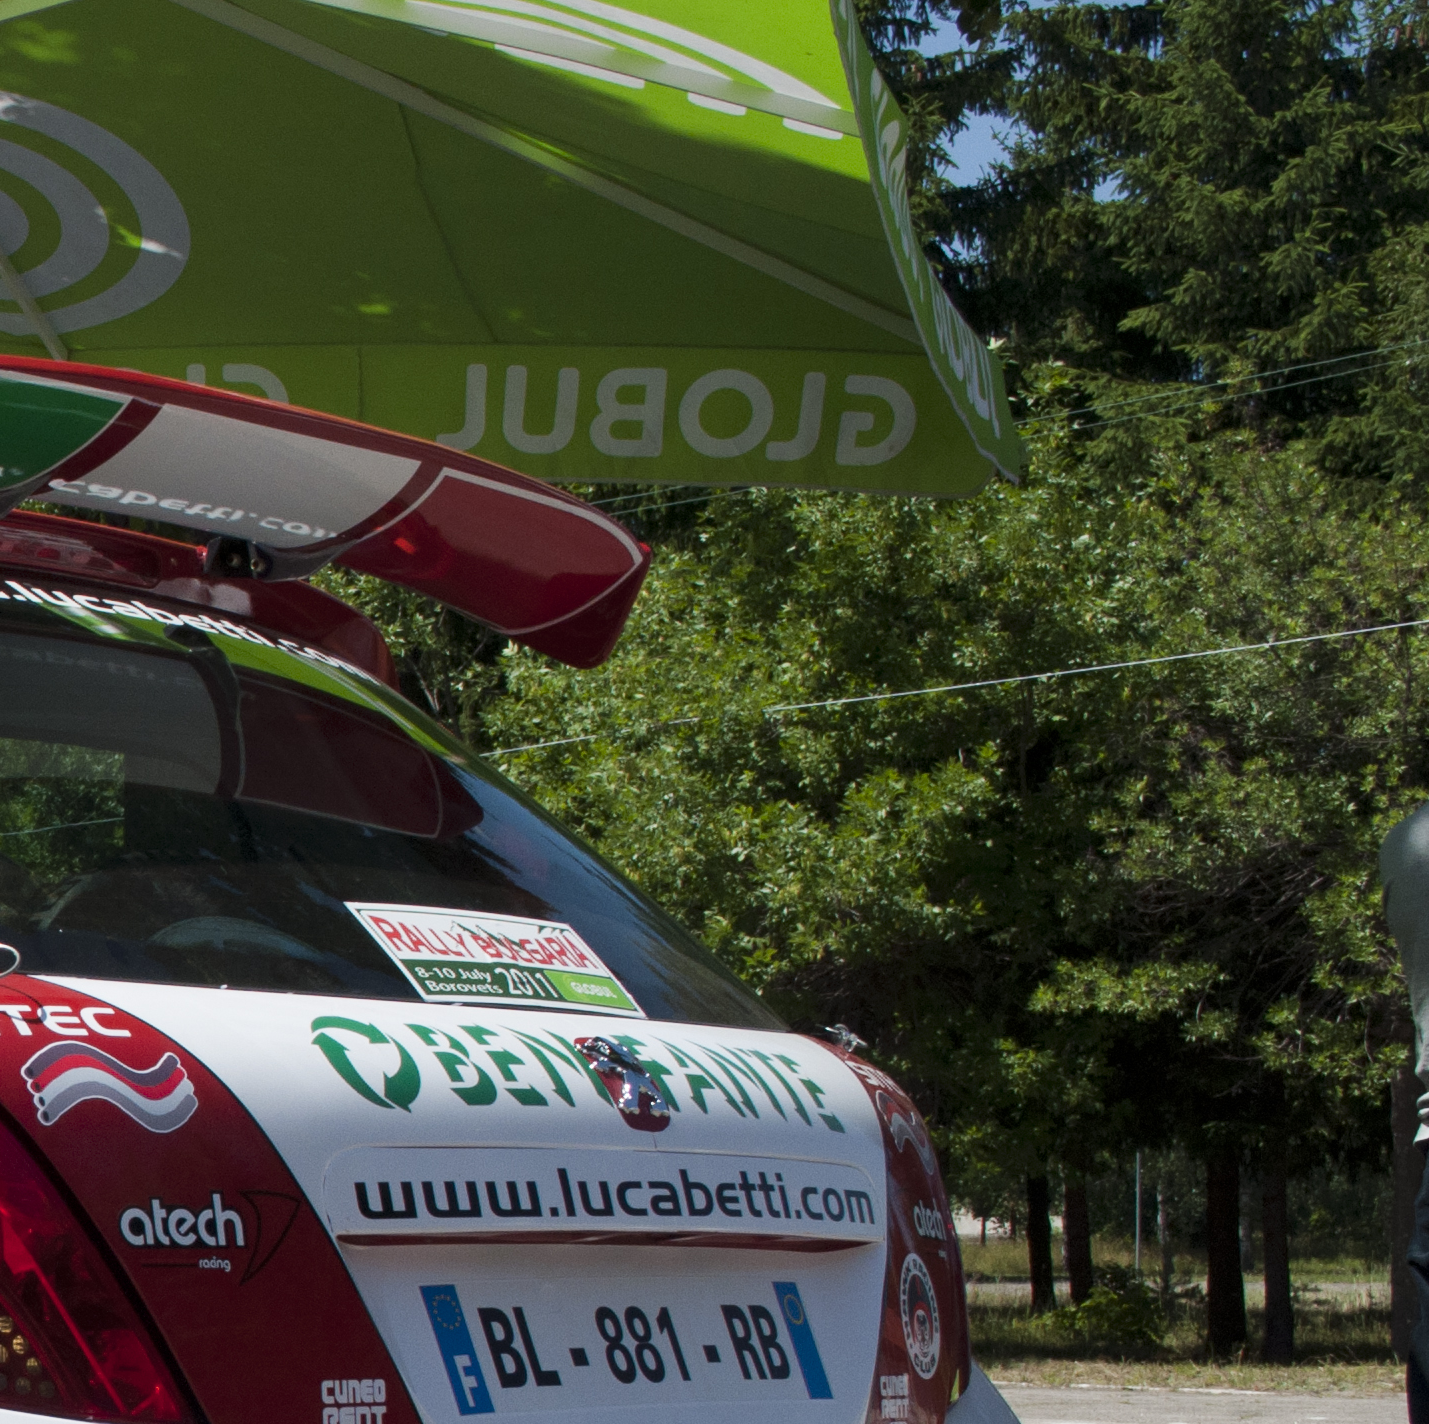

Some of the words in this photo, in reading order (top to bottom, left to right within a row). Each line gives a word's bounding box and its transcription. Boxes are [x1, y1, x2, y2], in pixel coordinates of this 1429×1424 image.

[367, 915, 476, 959] RALLY
[414, 966, 457, 980] 8-10
[459, 968, 492, 982] July
[425, 980, 503, 995] Borovets
[494, 967, 559, 999] 2011
[353, 1167, 877, 1226] www.lucabetti.com
[120, 1193, 245, 1248] atech
[198, 1256, 232, 1272] racing
[321, 1378, 387, 1404] CUNEO
[455, 1355, 481, 1409] F
